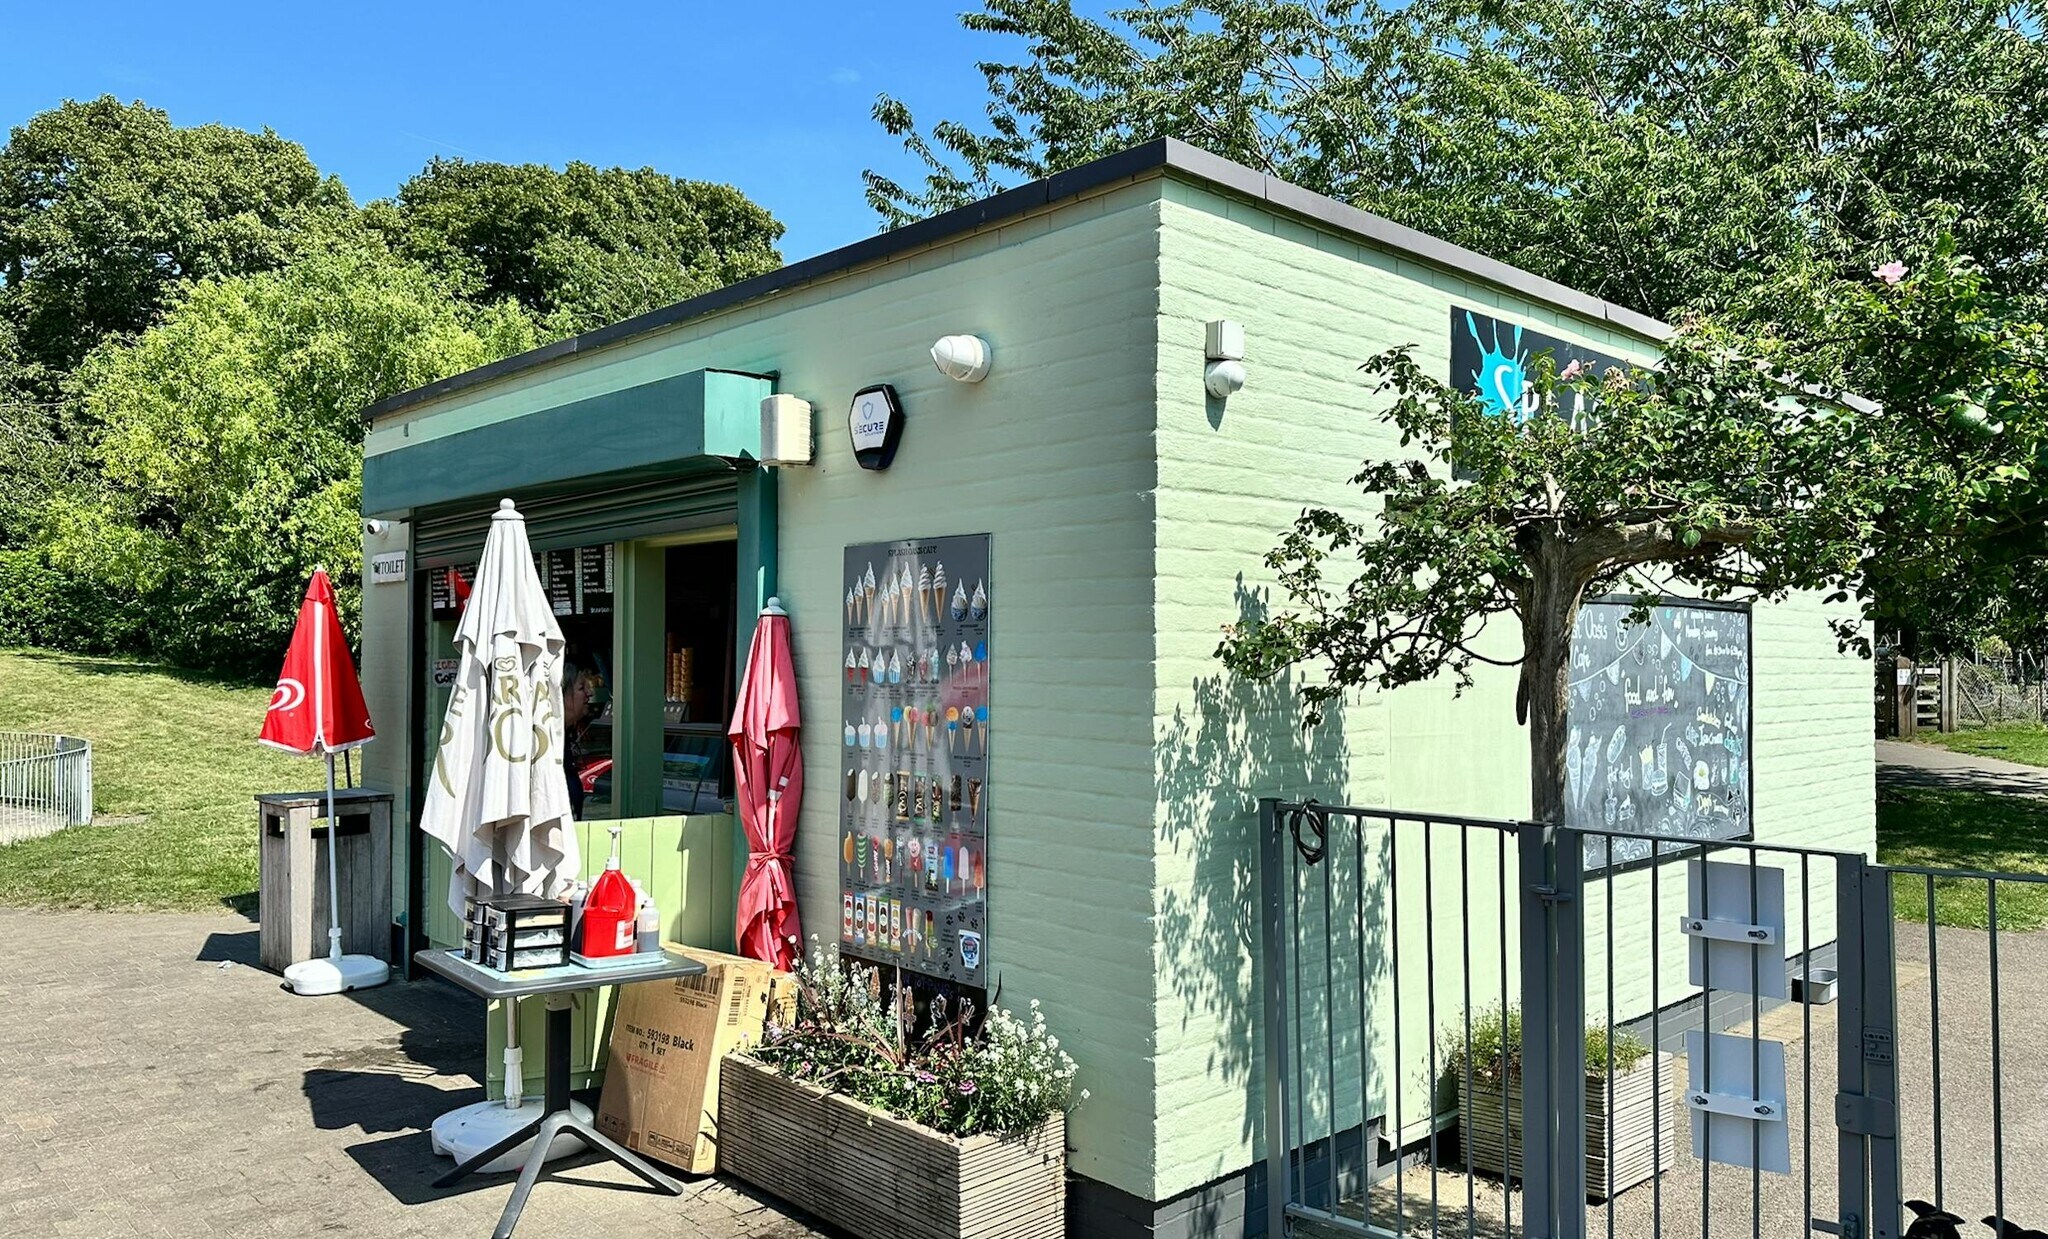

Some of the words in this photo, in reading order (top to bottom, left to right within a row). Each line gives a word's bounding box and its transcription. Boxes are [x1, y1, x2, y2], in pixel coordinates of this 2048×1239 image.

[854, 421, 884, 435] SECURE
[381, 559, 405, 575] TOILET
[647, 1028, 670, 1045] 593198
[673, 1035, 694, 1052] Black
[651, 1041, 656, 1055] 1
[656, 1047, 666, 1056] SET
[631, 1054, 659, 1071] FRAGILE
